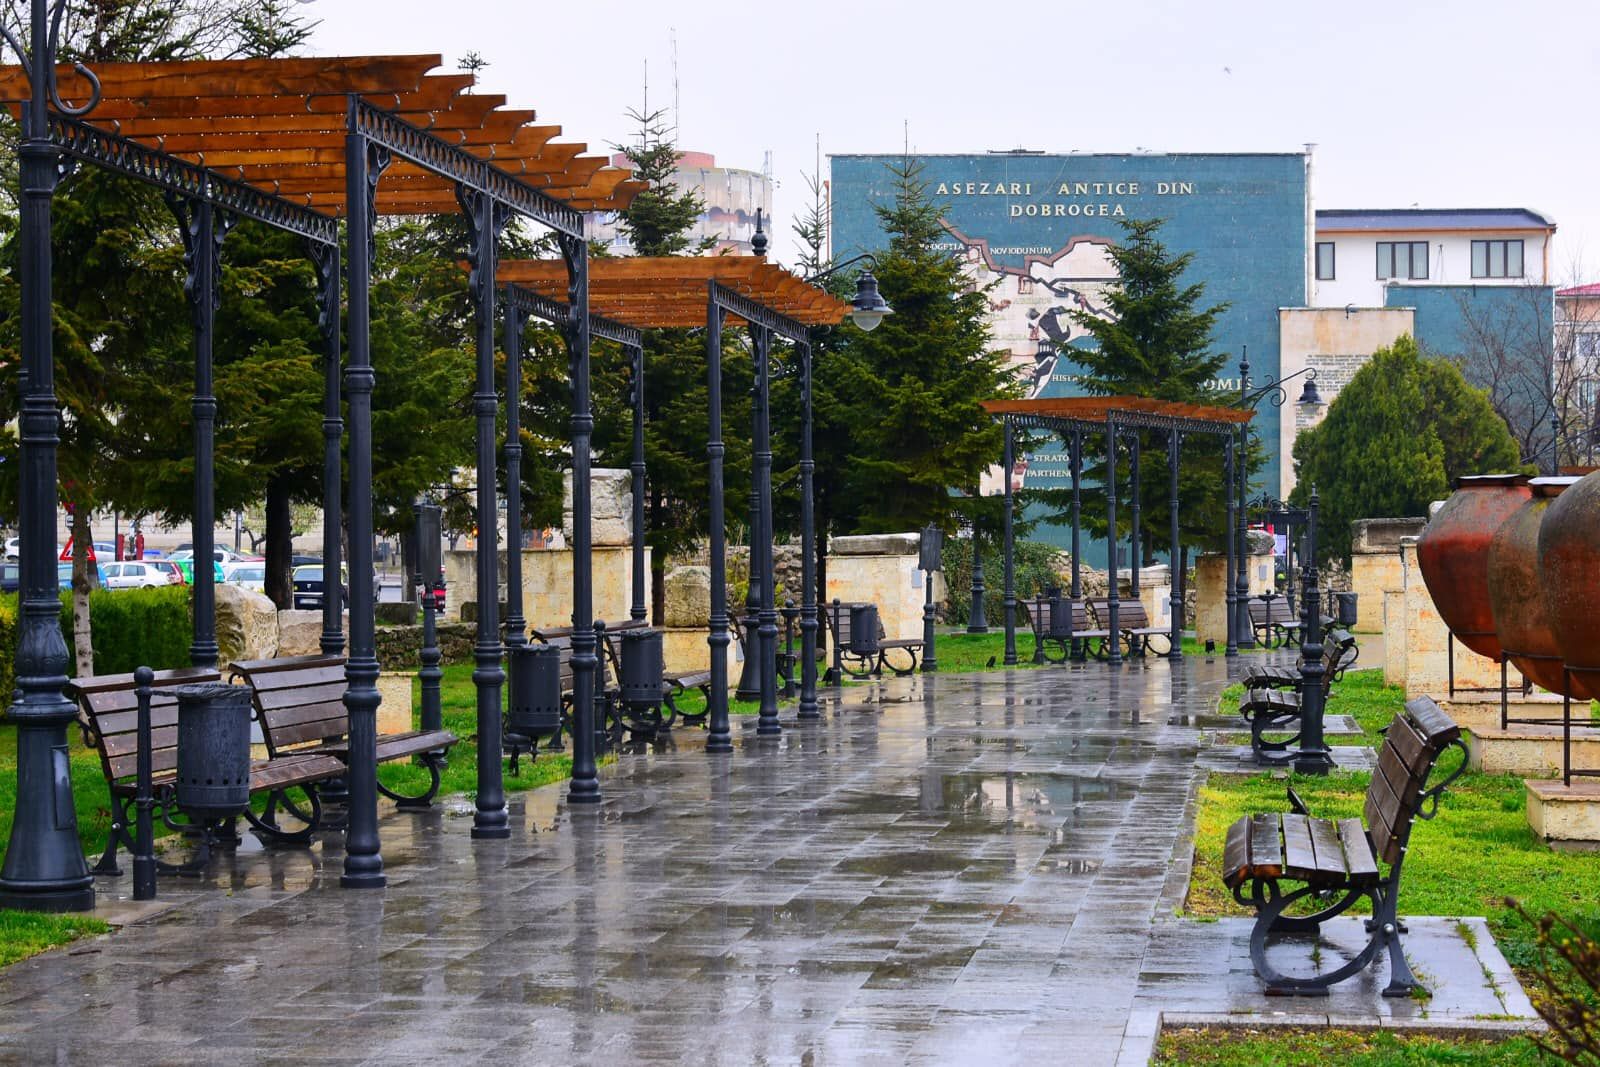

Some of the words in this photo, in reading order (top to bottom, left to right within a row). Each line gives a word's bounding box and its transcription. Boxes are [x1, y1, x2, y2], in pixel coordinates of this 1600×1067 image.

[936, 182, 1032, 195] ASEZARI
[1058, 182, 1139, 195] ANTICE
[1157, 182, 1193, 195] DIN
[1010, 204, 1126, 217] DOBROGEA
[990, 247, 1052, 255] NOVIODUNUM
